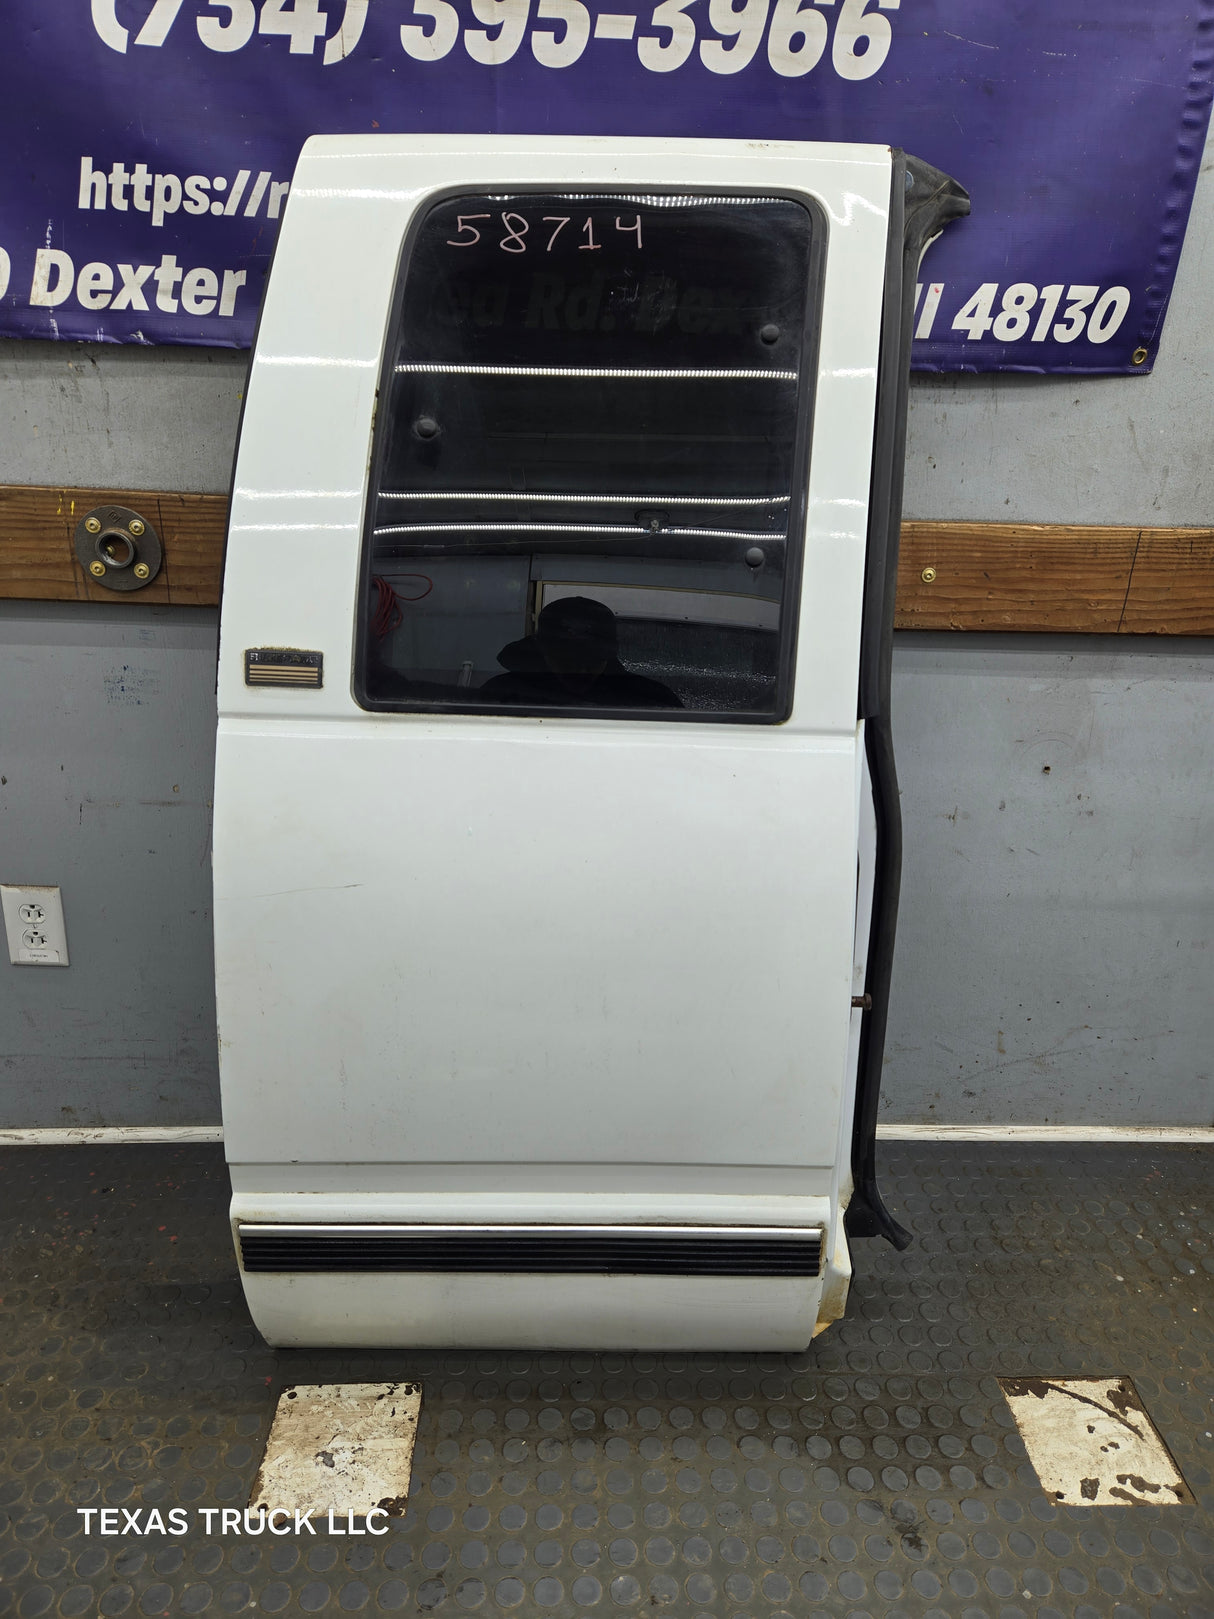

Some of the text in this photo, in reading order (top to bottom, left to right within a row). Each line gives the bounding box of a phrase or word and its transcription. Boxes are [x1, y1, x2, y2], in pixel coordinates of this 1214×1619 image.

[400, 0, 900, 81] 395-3966
[78, 157, 290, 227] https://r
[446, 212, 643, 253] 58714
[29, 248, 247, 317] Dexter
[914, 283, 945, 339] I
[951, 283, 1131, 344] 48130
